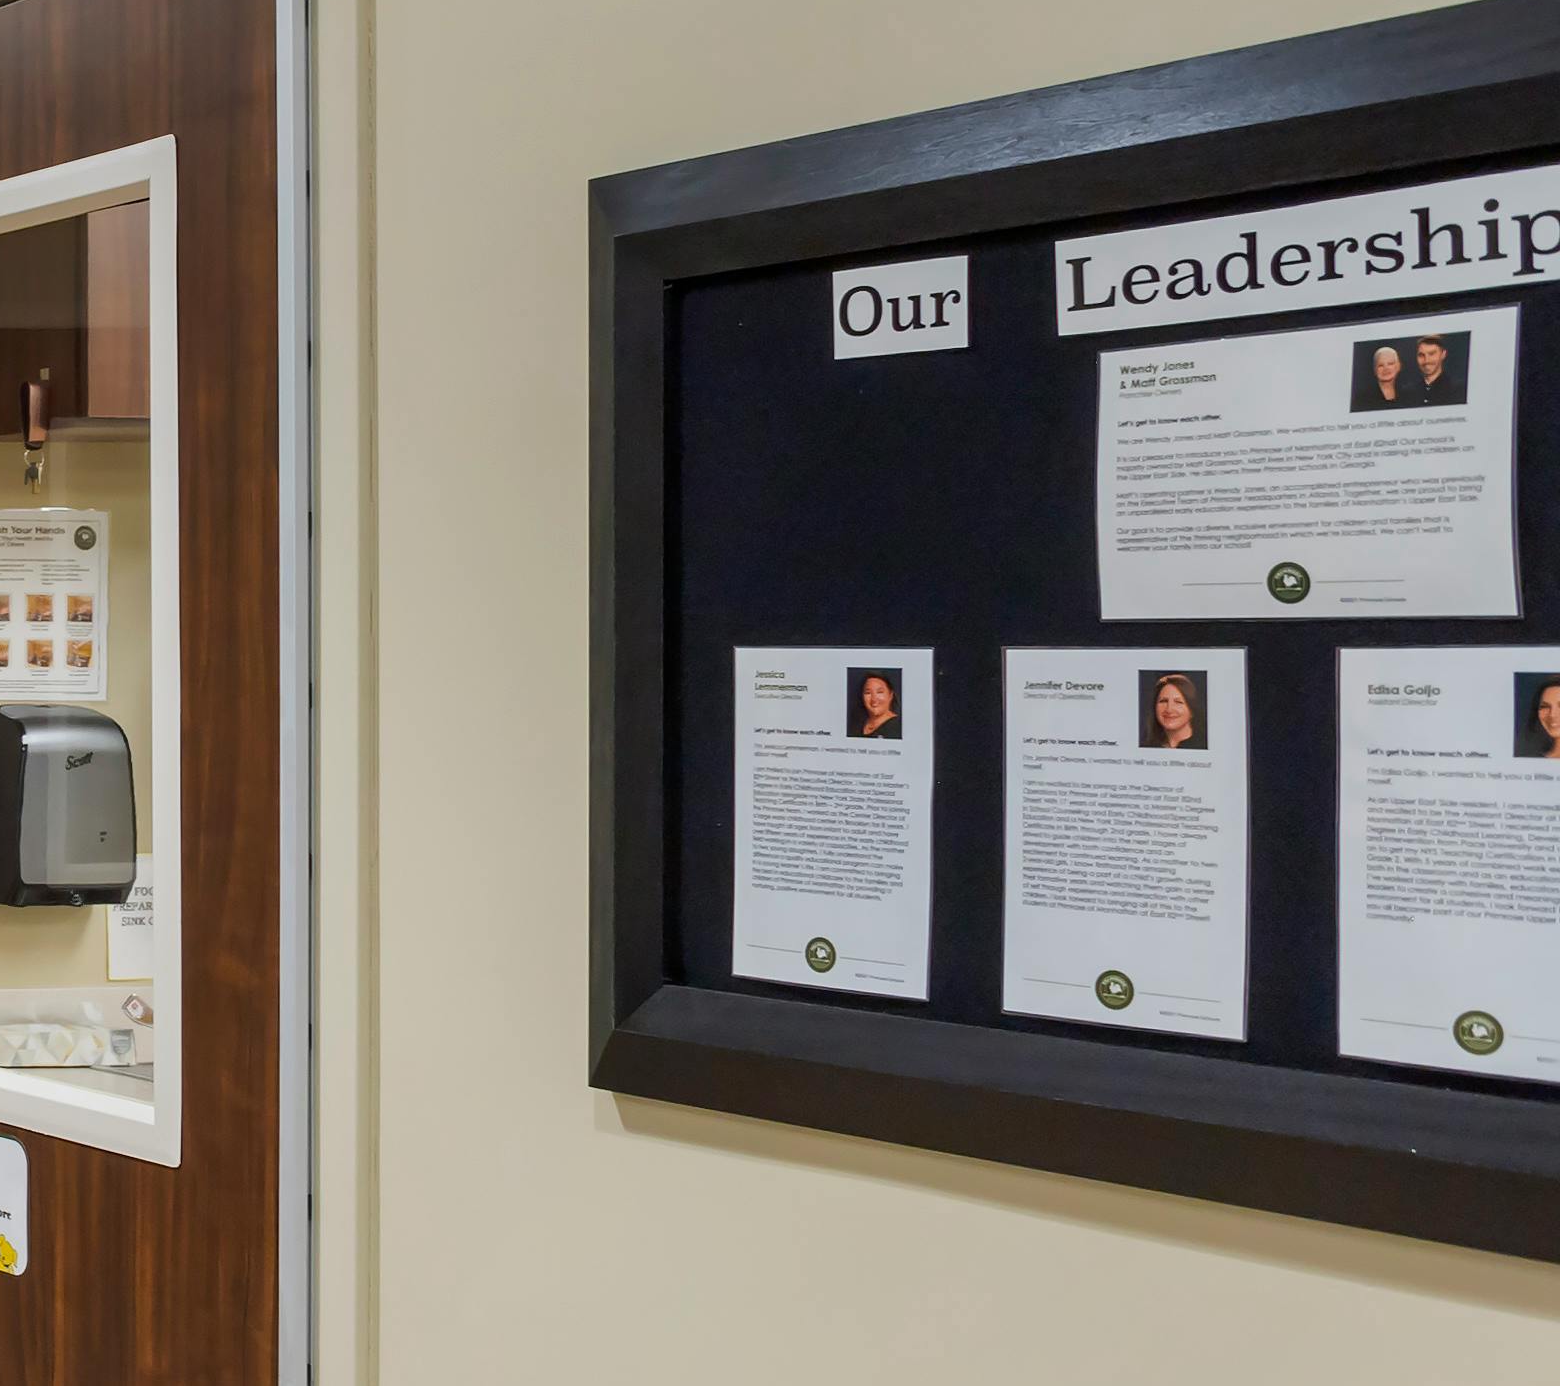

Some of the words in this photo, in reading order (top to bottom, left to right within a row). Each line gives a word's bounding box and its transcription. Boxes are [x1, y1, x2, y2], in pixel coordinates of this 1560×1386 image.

[1064, 197, 1560, 313] Leadership
[837, 284, 962, 338] Our
[1120, 363, 1159, 375] Wendy
[1163, 361, 1194, 372] Jones
[1065, 681, 1104, 691] Devore
[65, 751, 94, 771] Scott
